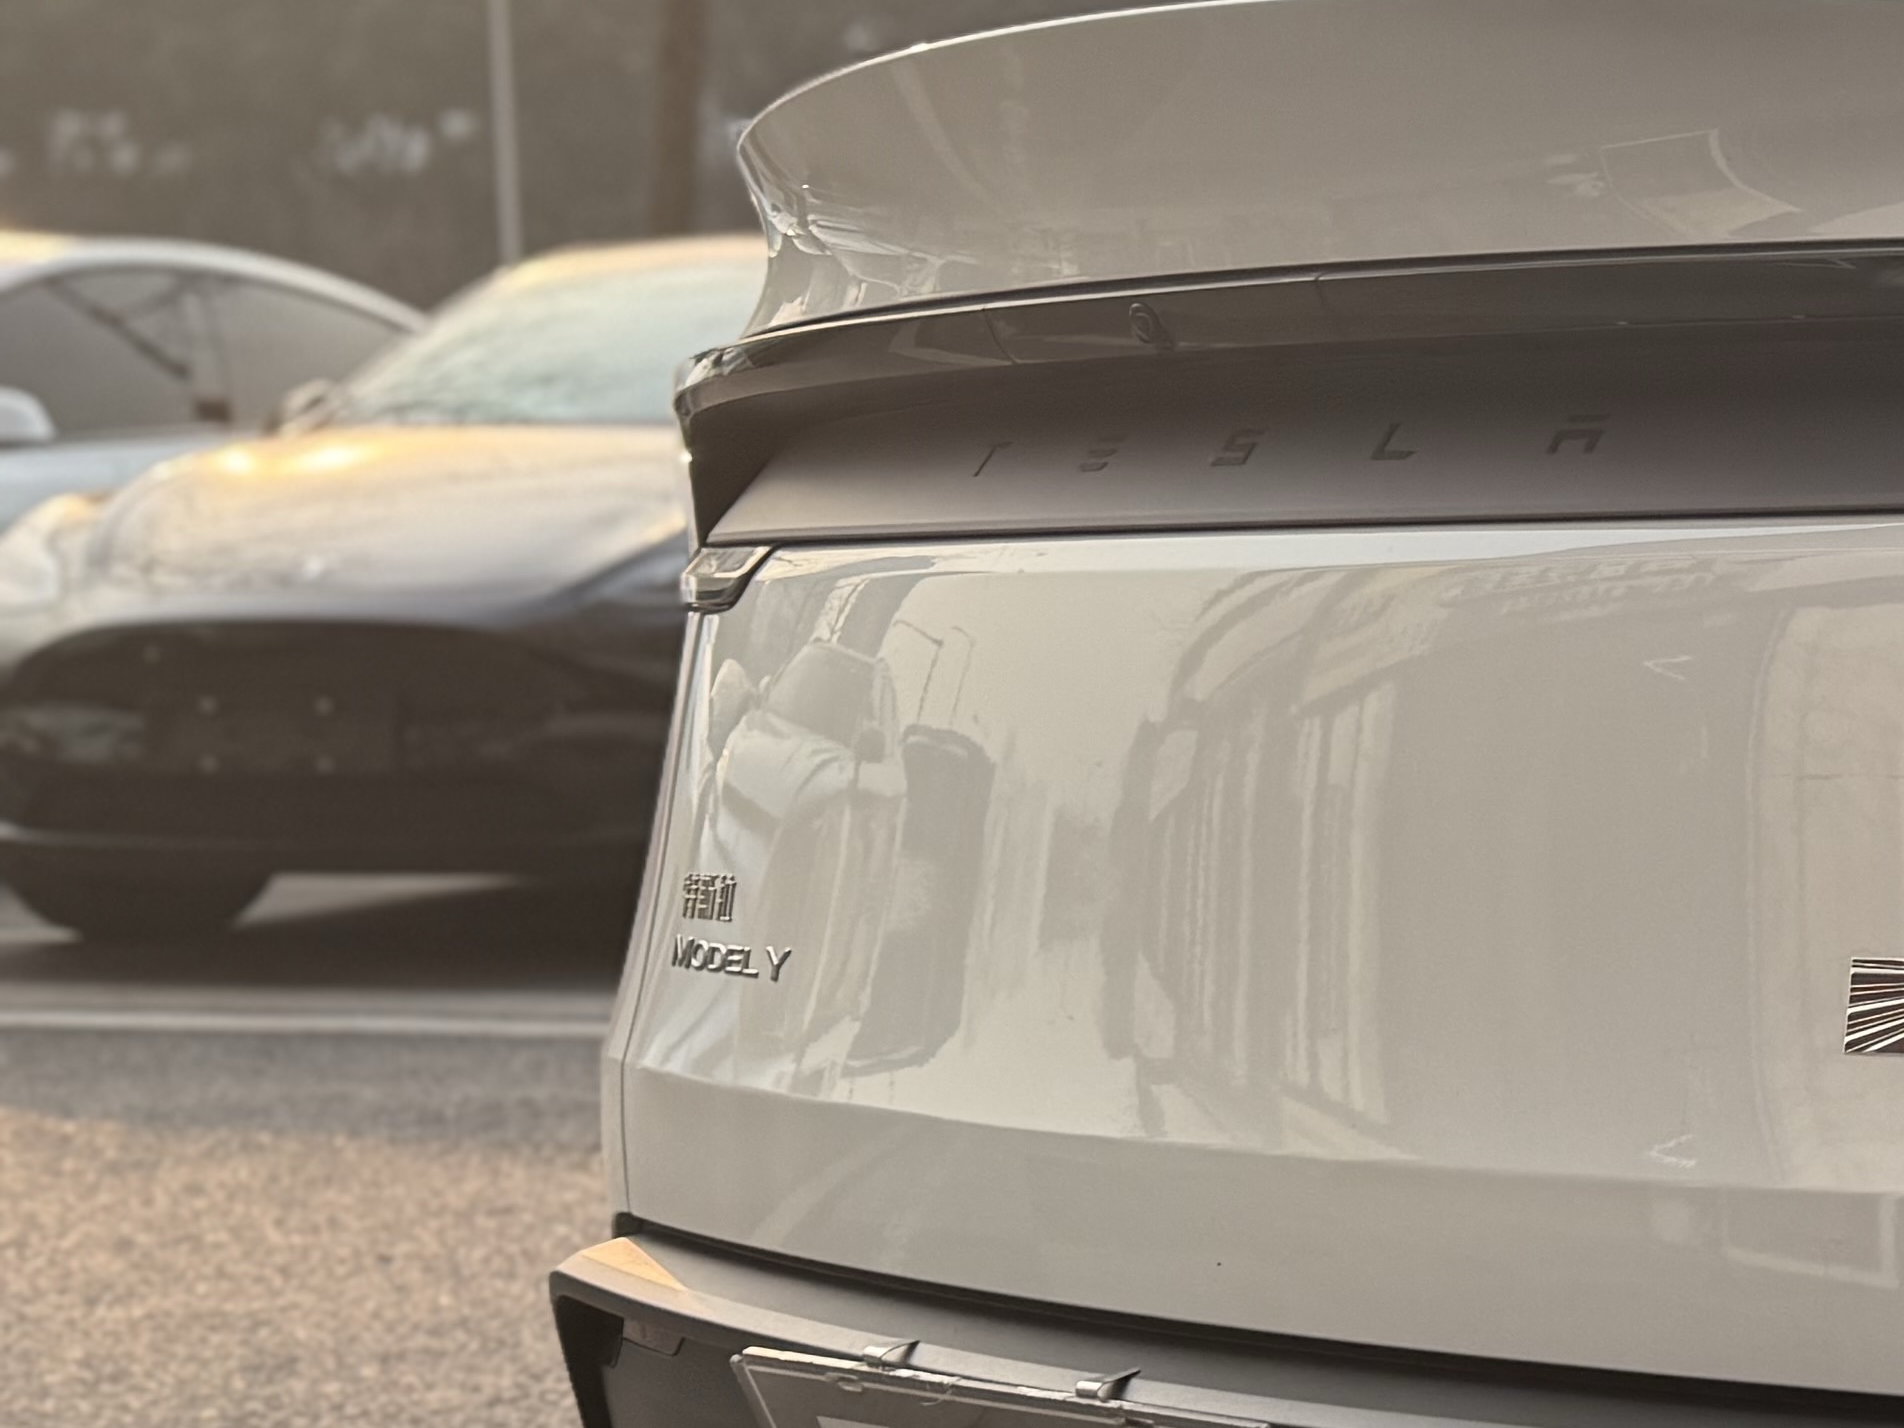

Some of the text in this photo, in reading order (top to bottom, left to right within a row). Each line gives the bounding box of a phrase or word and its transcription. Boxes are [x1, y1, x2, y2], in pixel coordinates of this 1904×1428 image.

[971, 412, 1611, 478] TESLA
[671, 933, 792, 983] MODEL Y
